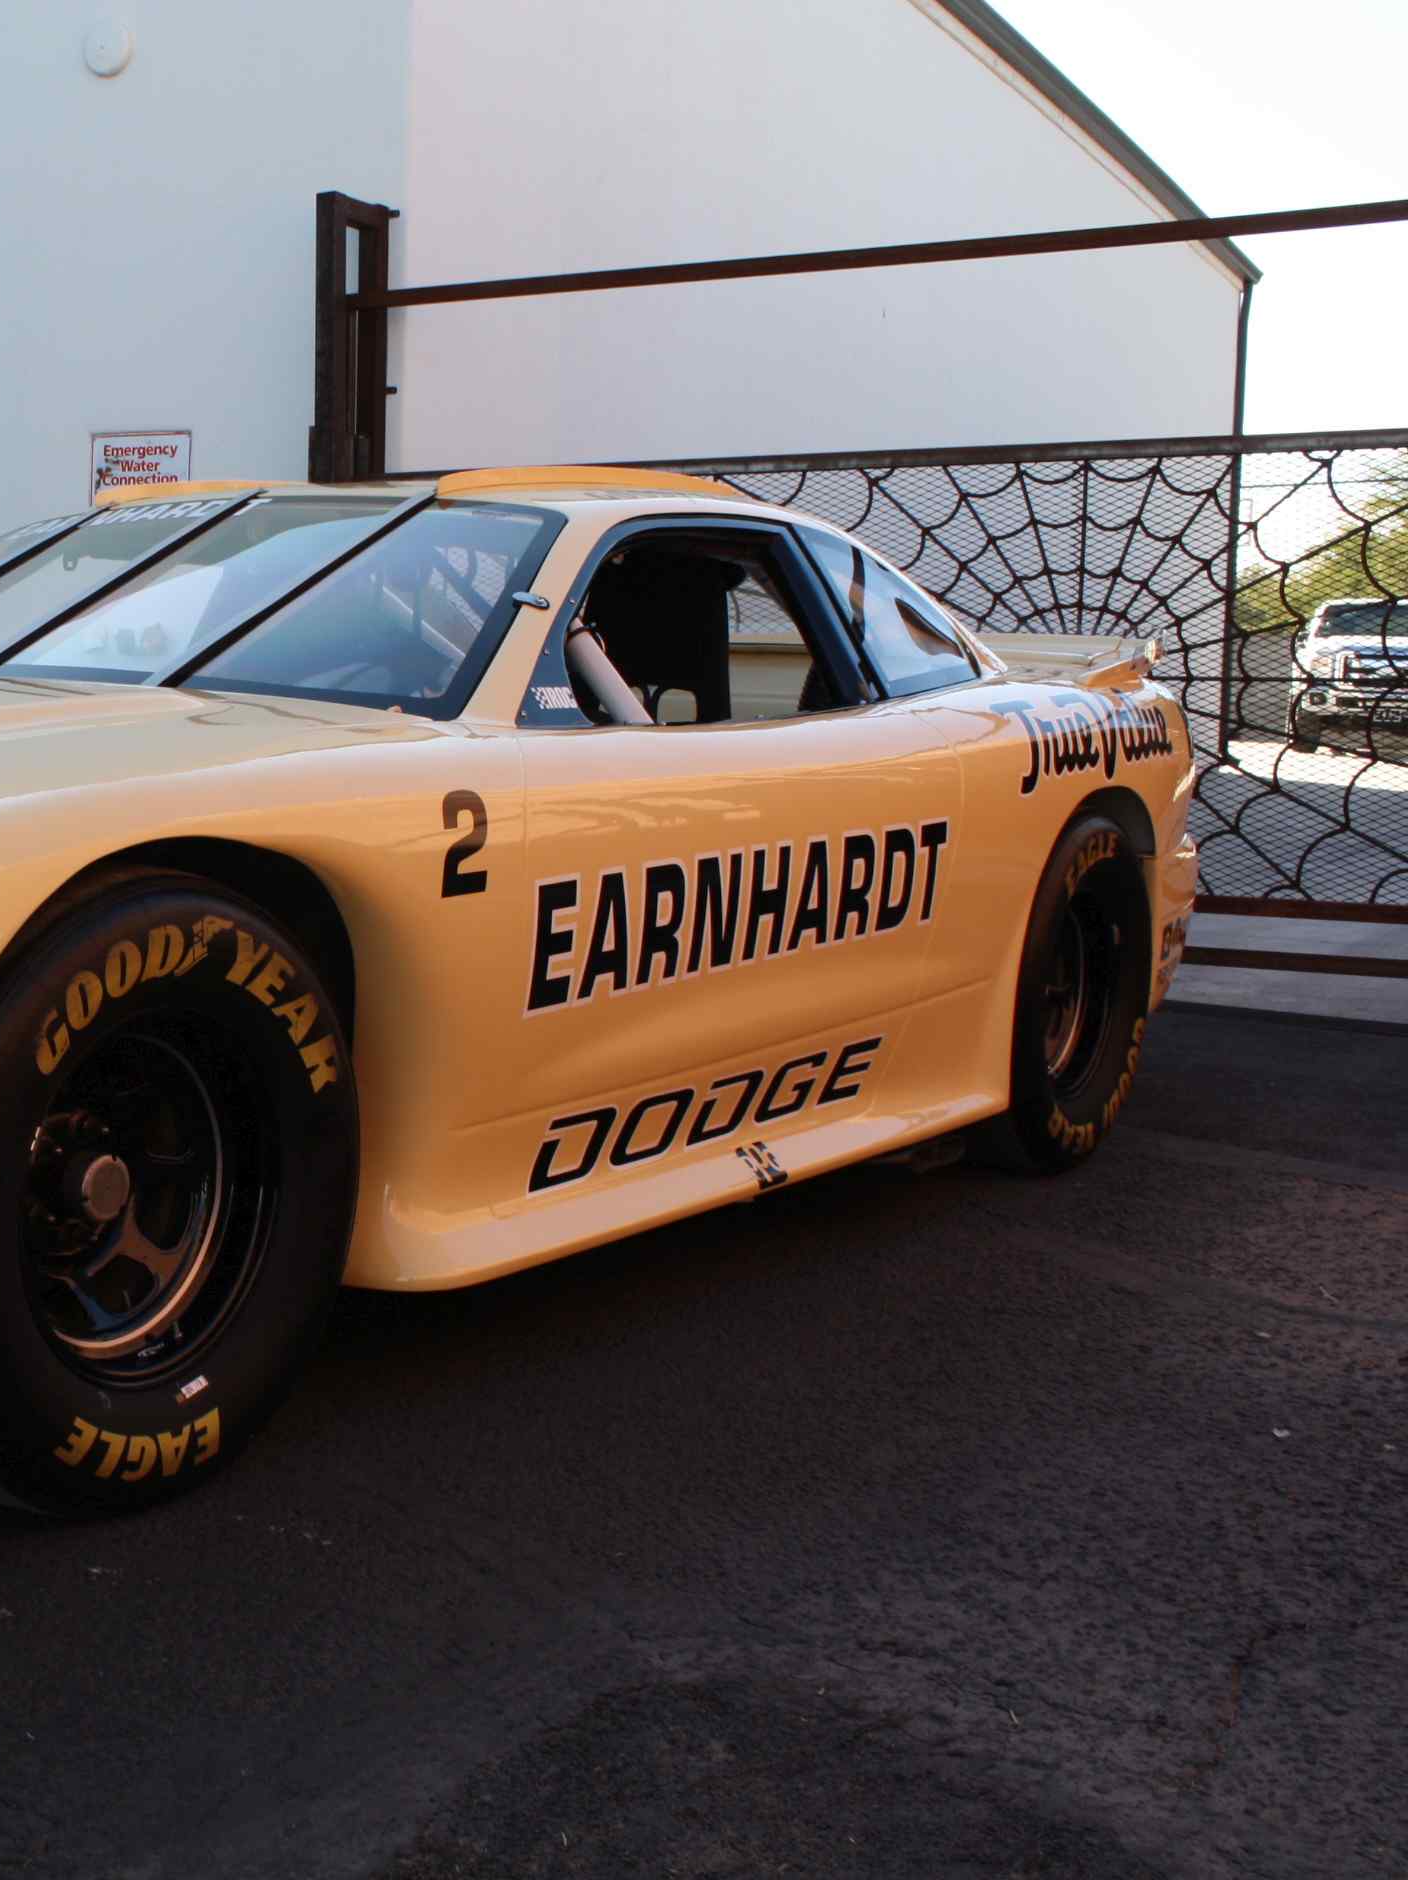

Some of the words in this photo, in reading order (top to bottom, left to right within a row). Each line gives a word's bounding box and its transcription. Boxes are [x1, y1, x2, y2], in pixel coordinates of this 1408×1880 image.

[102, 472, 178, 486] Connection
[103, 444, 178, 459] Emergency
[120, 459, 161, 473] Water
[990, 699, 1100, 795] True
[1049, 687, 1172, 780] Value
[440, 789, 489, 899] 2
[523, 816, 951, 1018] EARNHARDT
[36, 915, 338, 1094] GOODYEAR
[526, 1034, 886, 1194] DODGE
[54, 1407, 221, 1481] EAGLE
